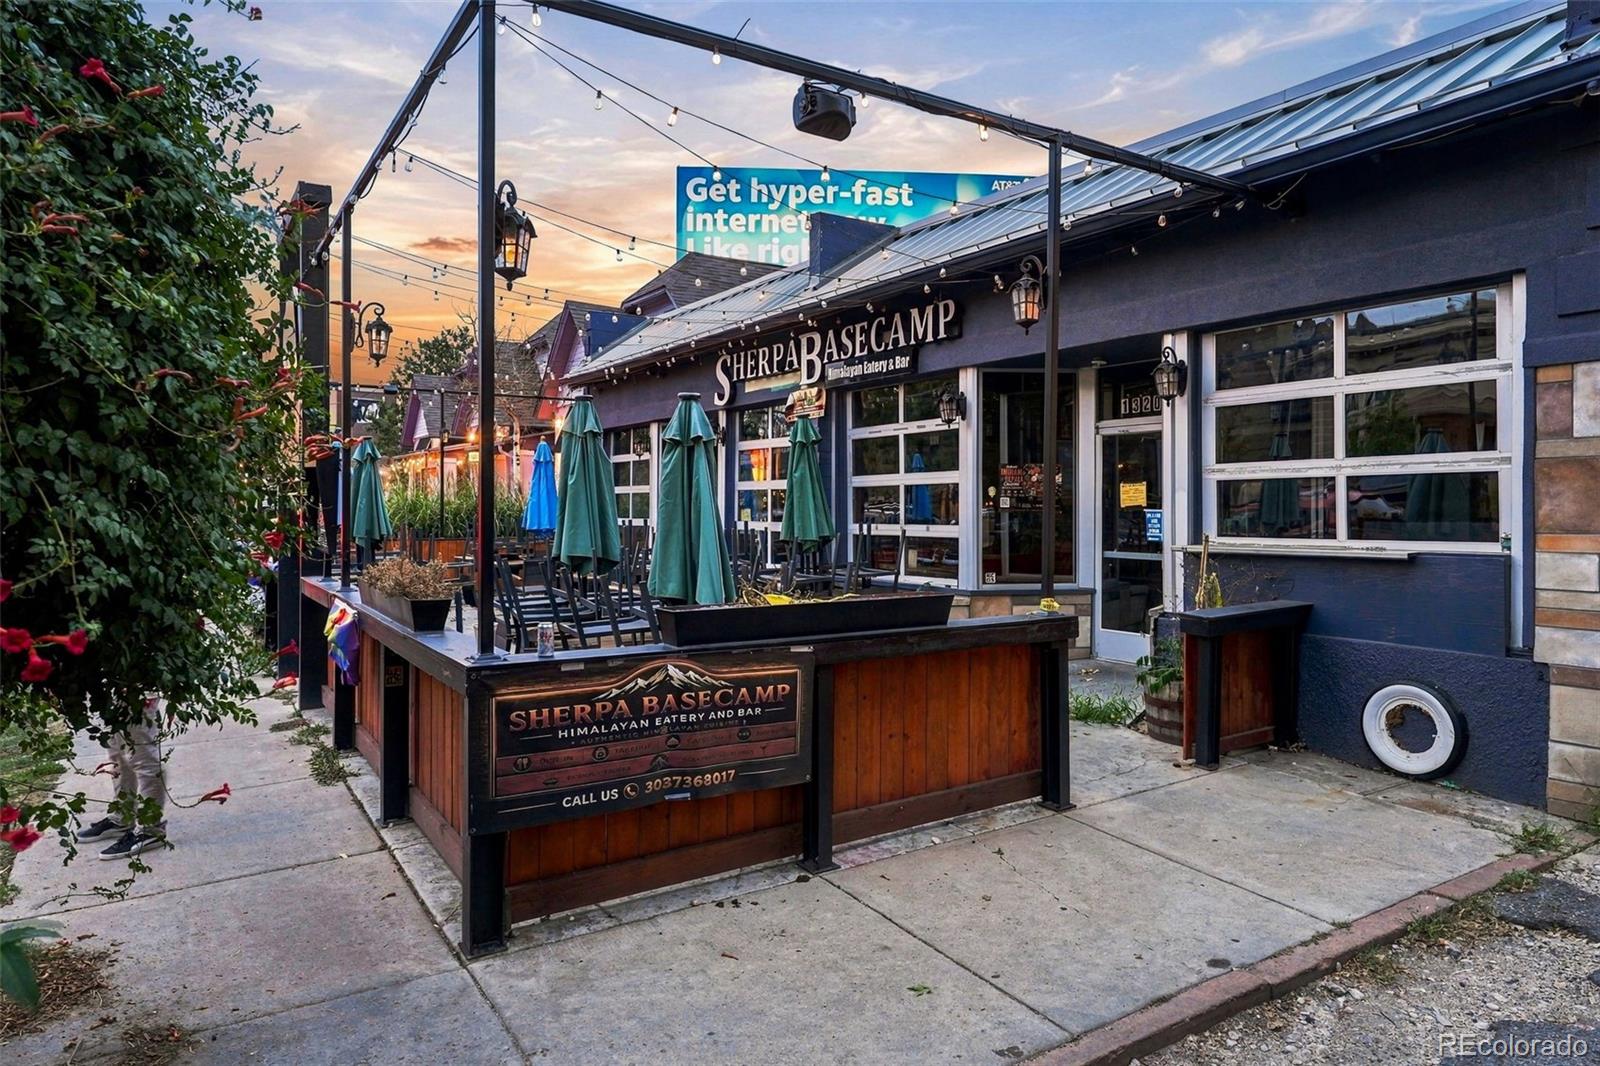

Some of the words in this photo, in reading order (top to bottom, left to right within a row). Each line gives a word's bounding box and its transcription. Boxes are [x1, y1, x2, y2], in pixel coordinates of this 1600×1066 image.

[686, 177, 741, 203] Get
[750, 177, 913, 210] hyper-fast
[686, 205, 810, 234] internet
[714, 339, 799, 406] SHERPA
[800, 299, 956, 386] BASECAMP
[863, 359, 887, 374] Eatery
[888, 358, 894, 370] &
[895, 355, 910, 369] Bar
[1121, 395, 1162, 414] 1320
[509, 699, 633, 732] SHERPA
[642, 684, 791, 716] BASECAMP
[558, 719, 650, 739] HIMALAYAN
[655, 712, 705, 726] EATERY
[708, 709, 734, 720] AND
[737, 707, 762, 717] BAR
[562, 792, 597, 807] CALL
[601, 789, 619, 801] US
[645, 769, 736, 793] 3037368017
